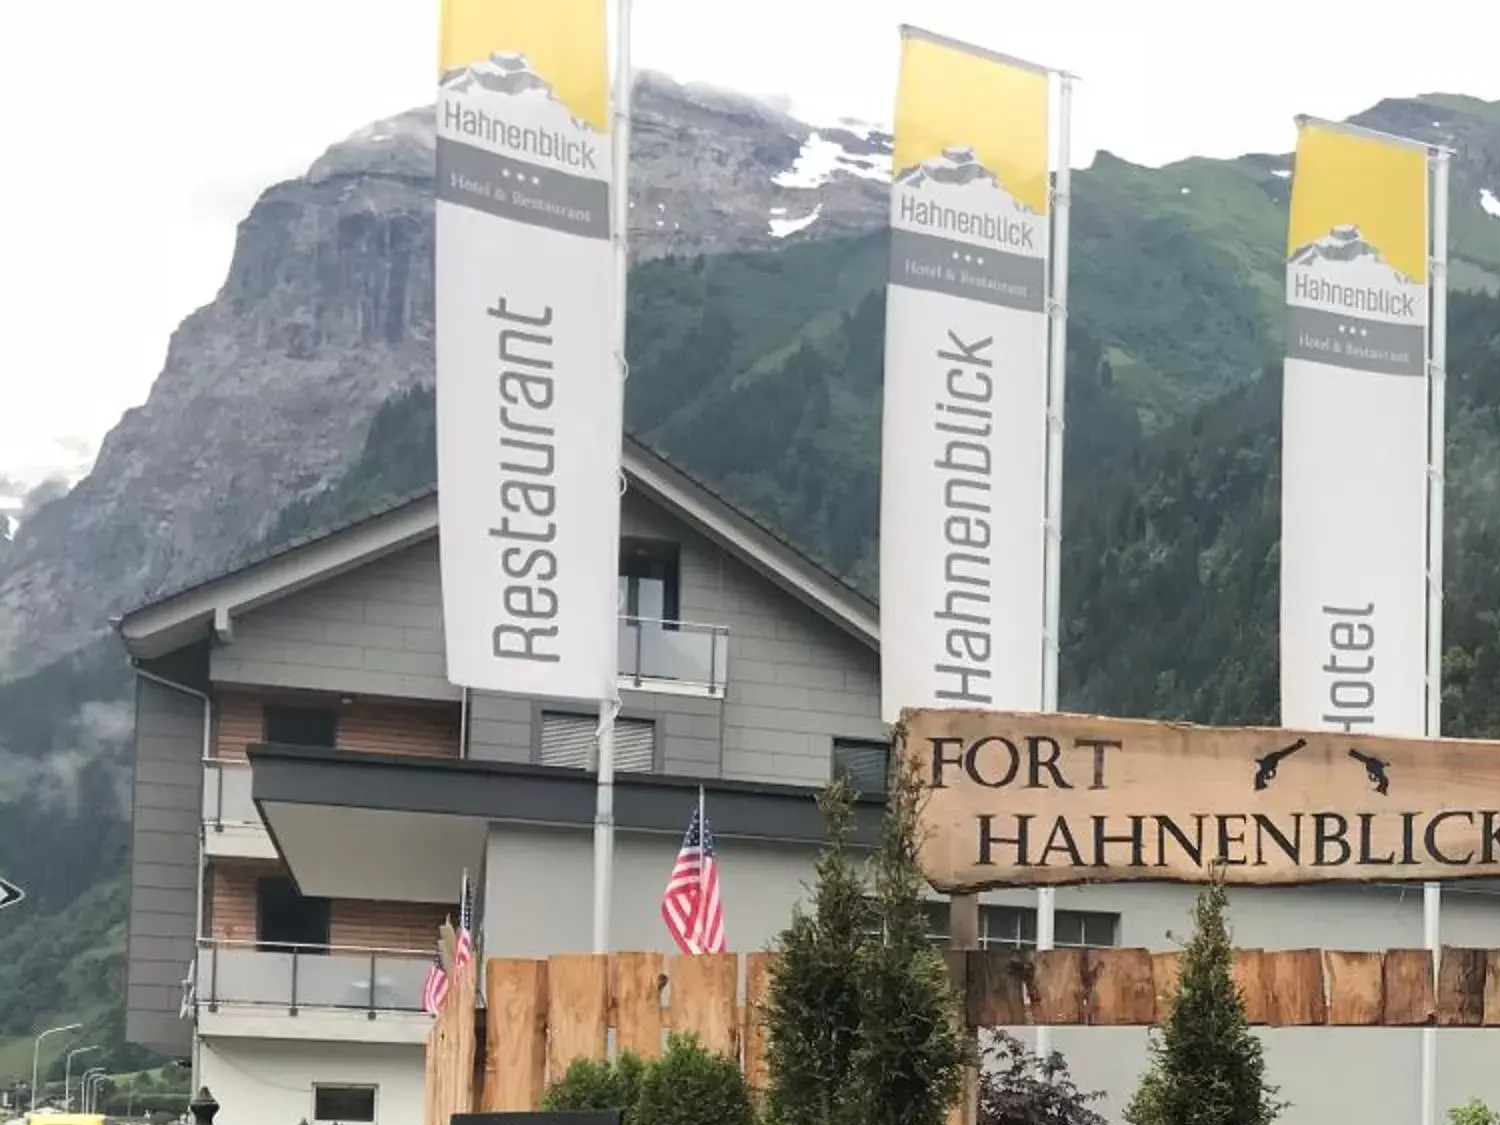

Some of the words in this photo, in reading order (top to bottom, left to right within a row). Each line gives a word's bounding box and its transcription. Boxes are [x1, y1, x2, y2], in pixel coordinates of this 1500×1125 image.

[444, 98, 596, 170] Hahnenblick
[901, 192, 1034, 249] Hahnenblick
[1295, 272, 1416, 317] Hahnenblick
[487, 296, 561, 662] Restaurant
[934, 328, 994, 704] Hahnenblick
[925, 735, 1123, 790] FORT
